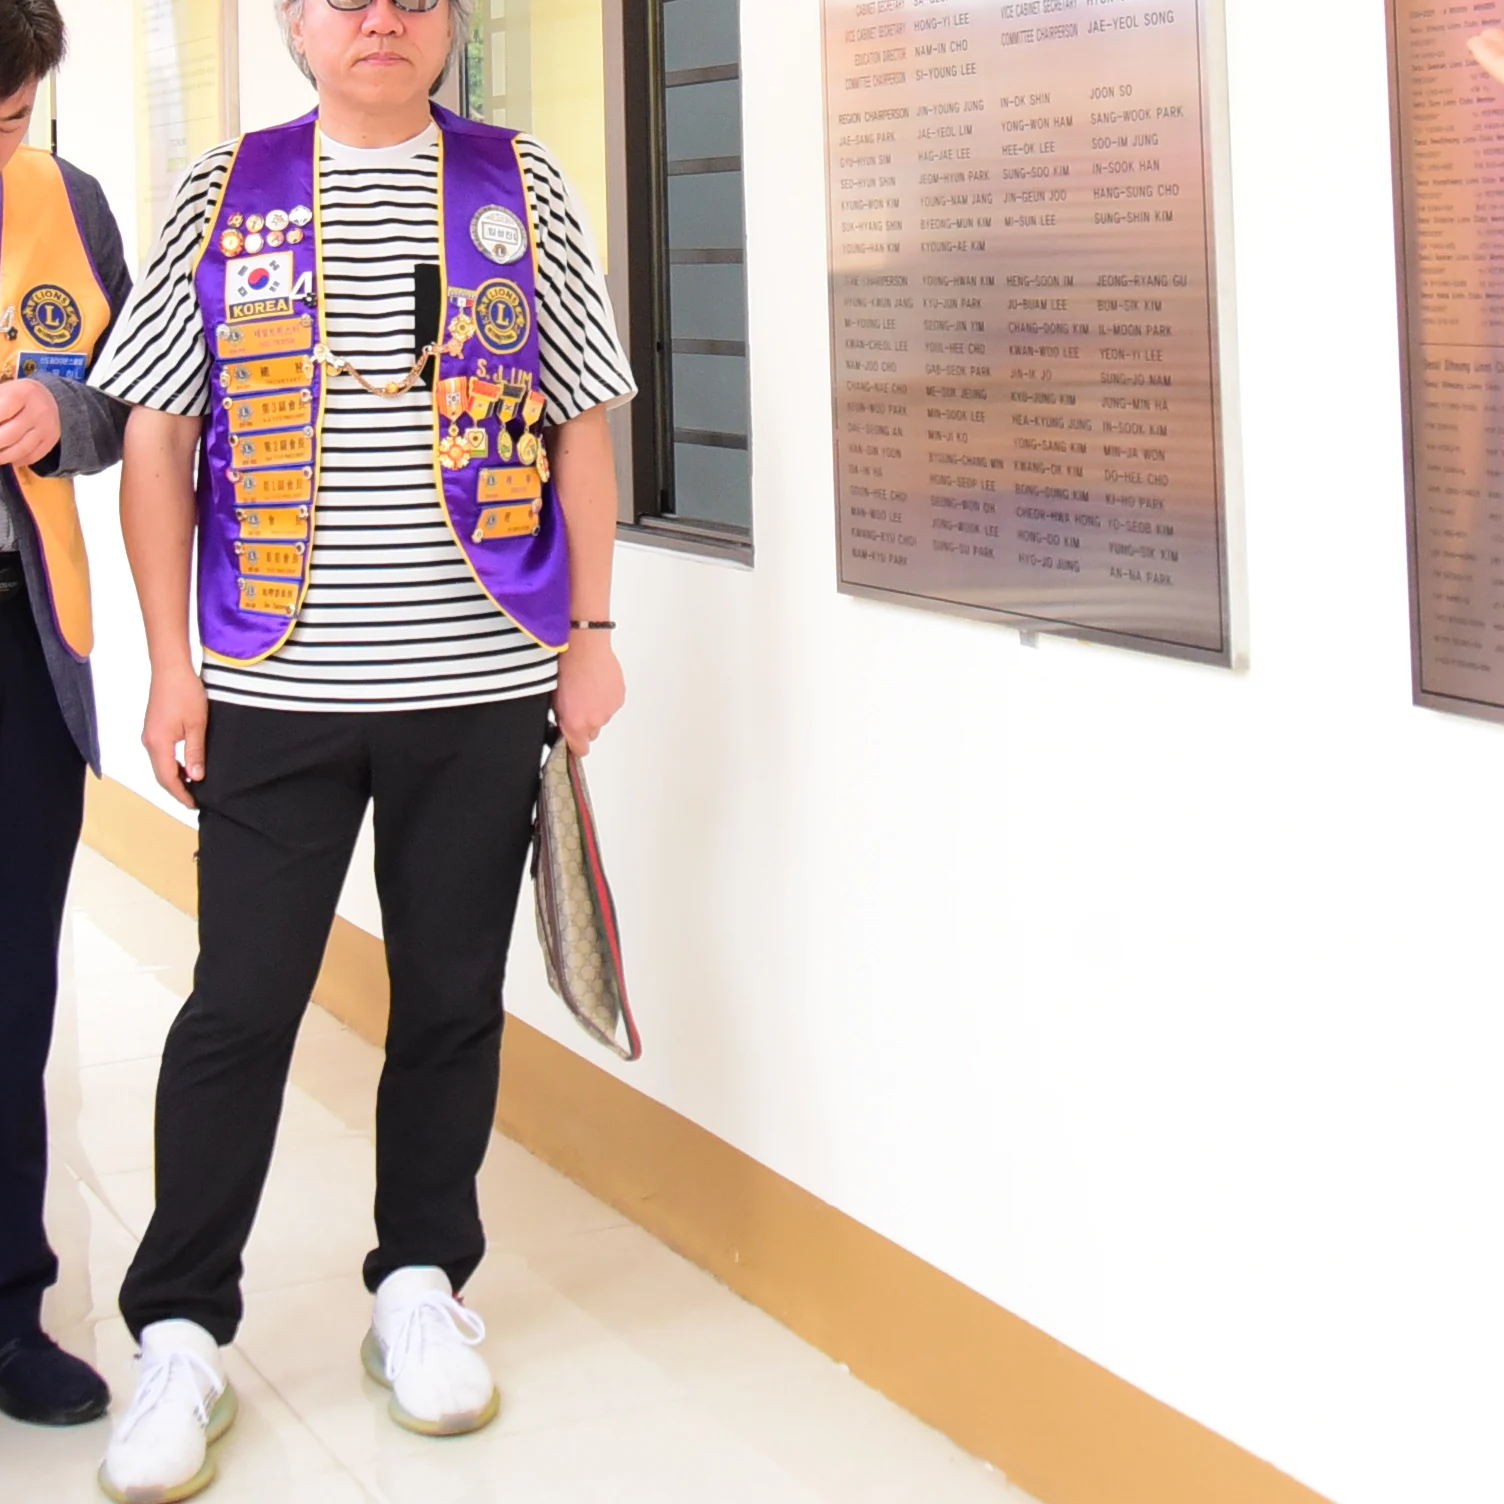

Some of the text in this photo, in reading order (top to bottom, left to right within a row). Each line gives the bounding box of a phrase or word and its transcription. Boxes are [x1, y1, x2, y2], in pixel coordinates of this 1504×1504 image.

[35, 290, 68, 304] LIONS
[490, 288, 519, 307] LIONS
[44, 305, 60, 326] L
[233, 301, 288, 318] KOREA
[496, 302, 510, 326] L
